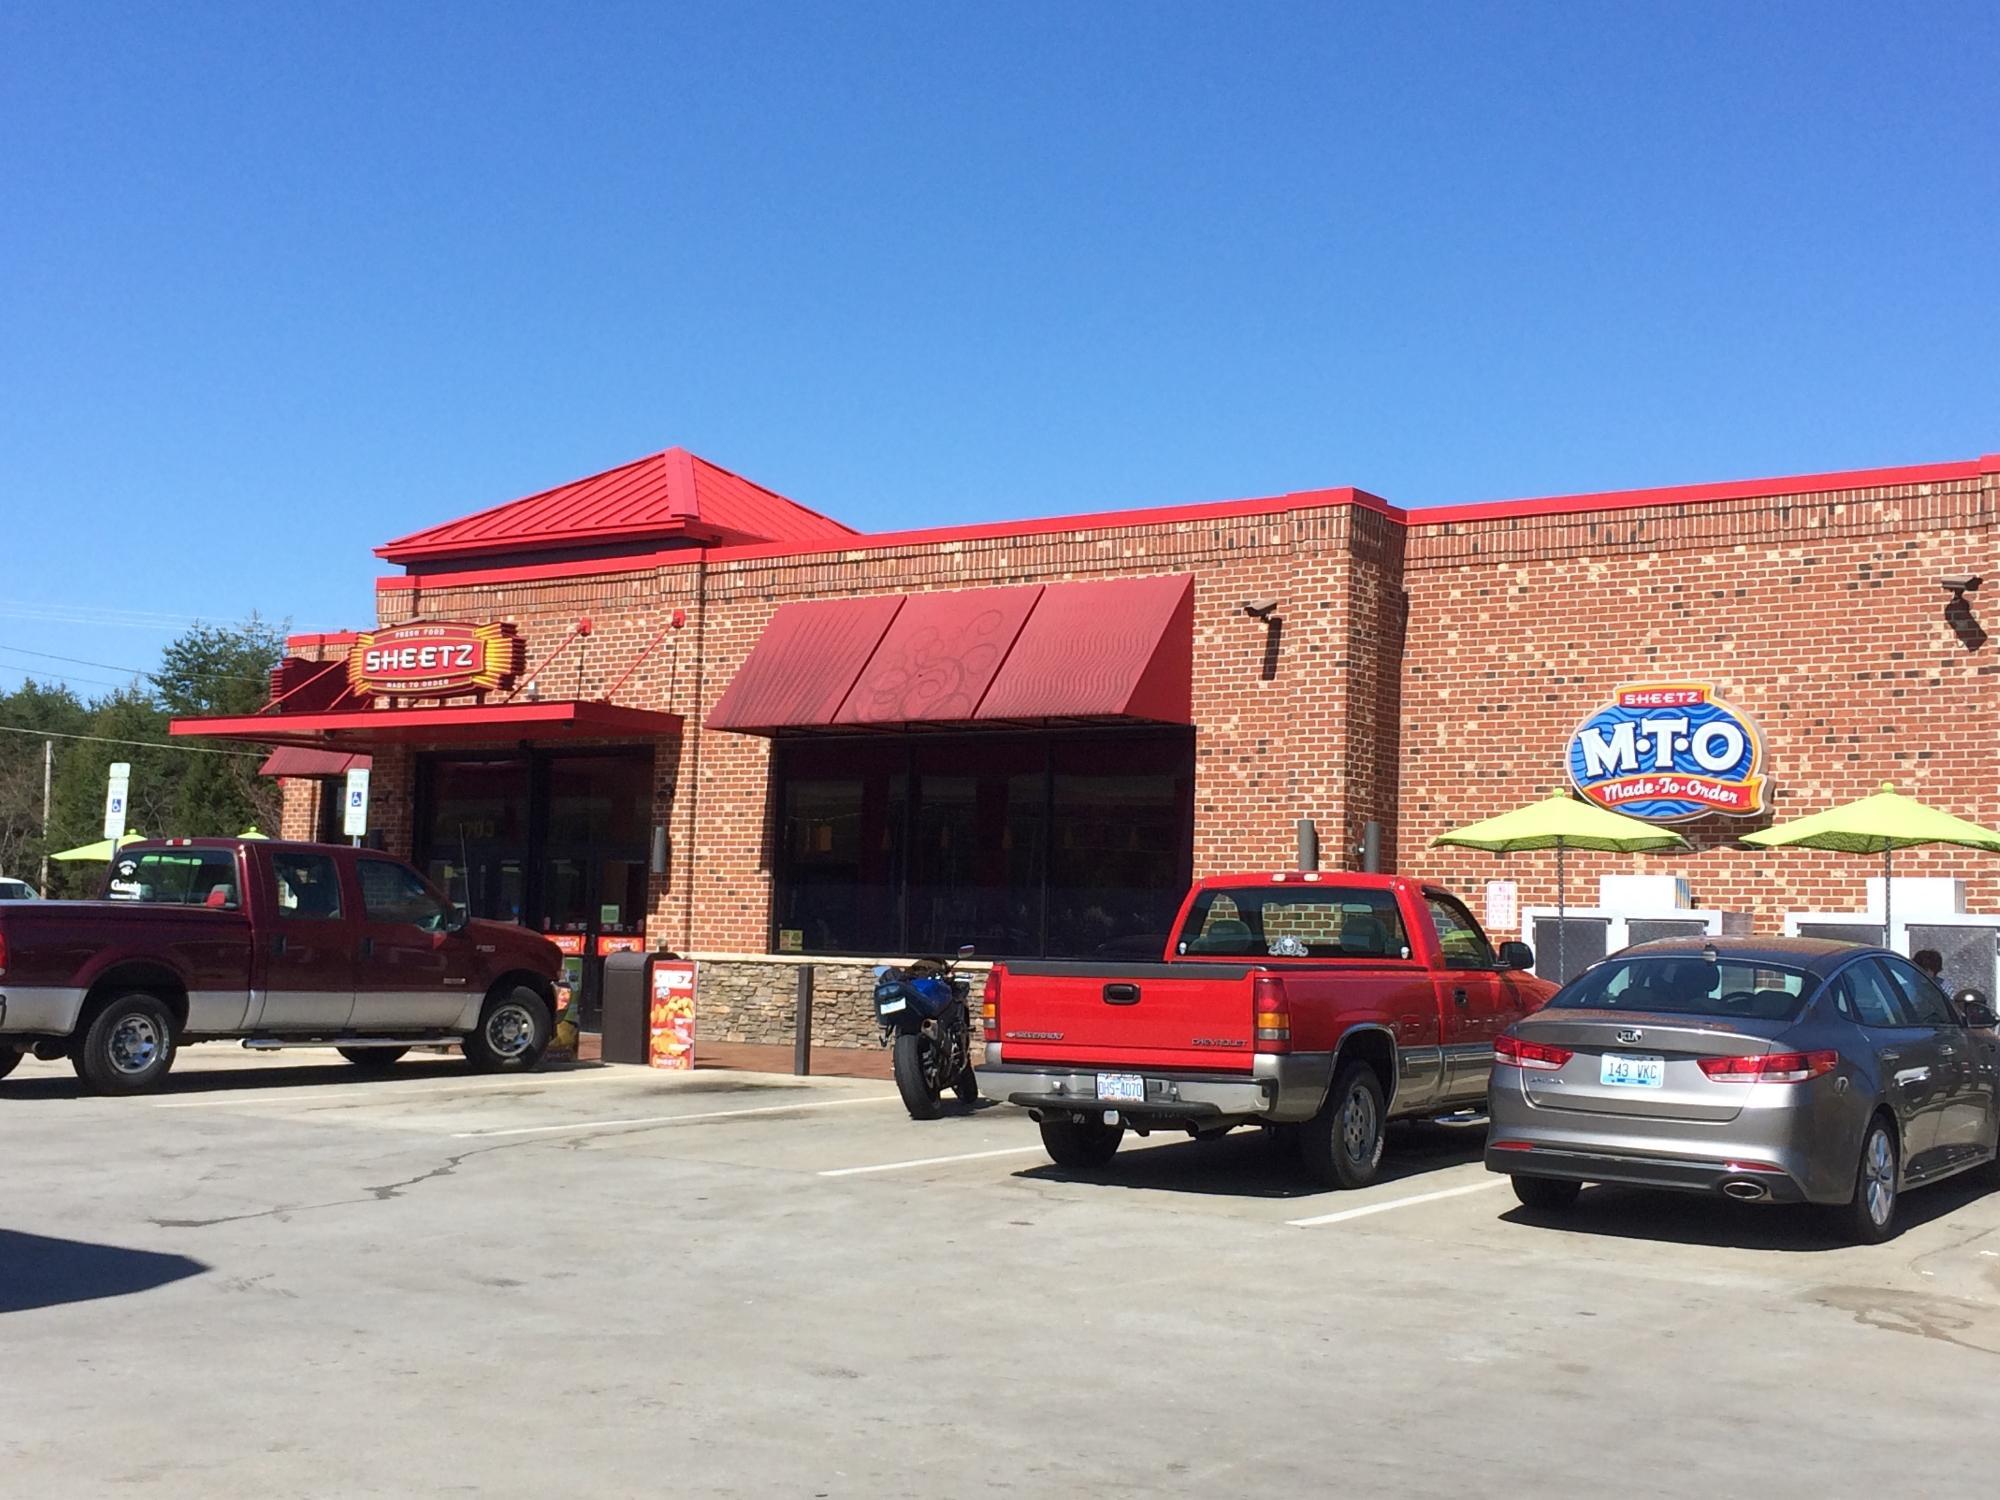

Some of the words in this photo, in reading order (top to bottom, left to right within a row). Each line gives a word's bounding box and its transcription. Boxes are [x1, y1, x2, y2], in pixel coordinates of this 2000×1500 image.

[423, 628, 446, 636] FOOD
[365, 644, 474, 672] SHEETZ
[421, 679, 449, 687] ORDER
[1624, 691, 1699, 705] SHEETZ
[1619, 1030, 1639, 1041] KIA
[1608, 1062, 1629, 1078] 143
[1637, 1064, 1658, 1079] VKC
